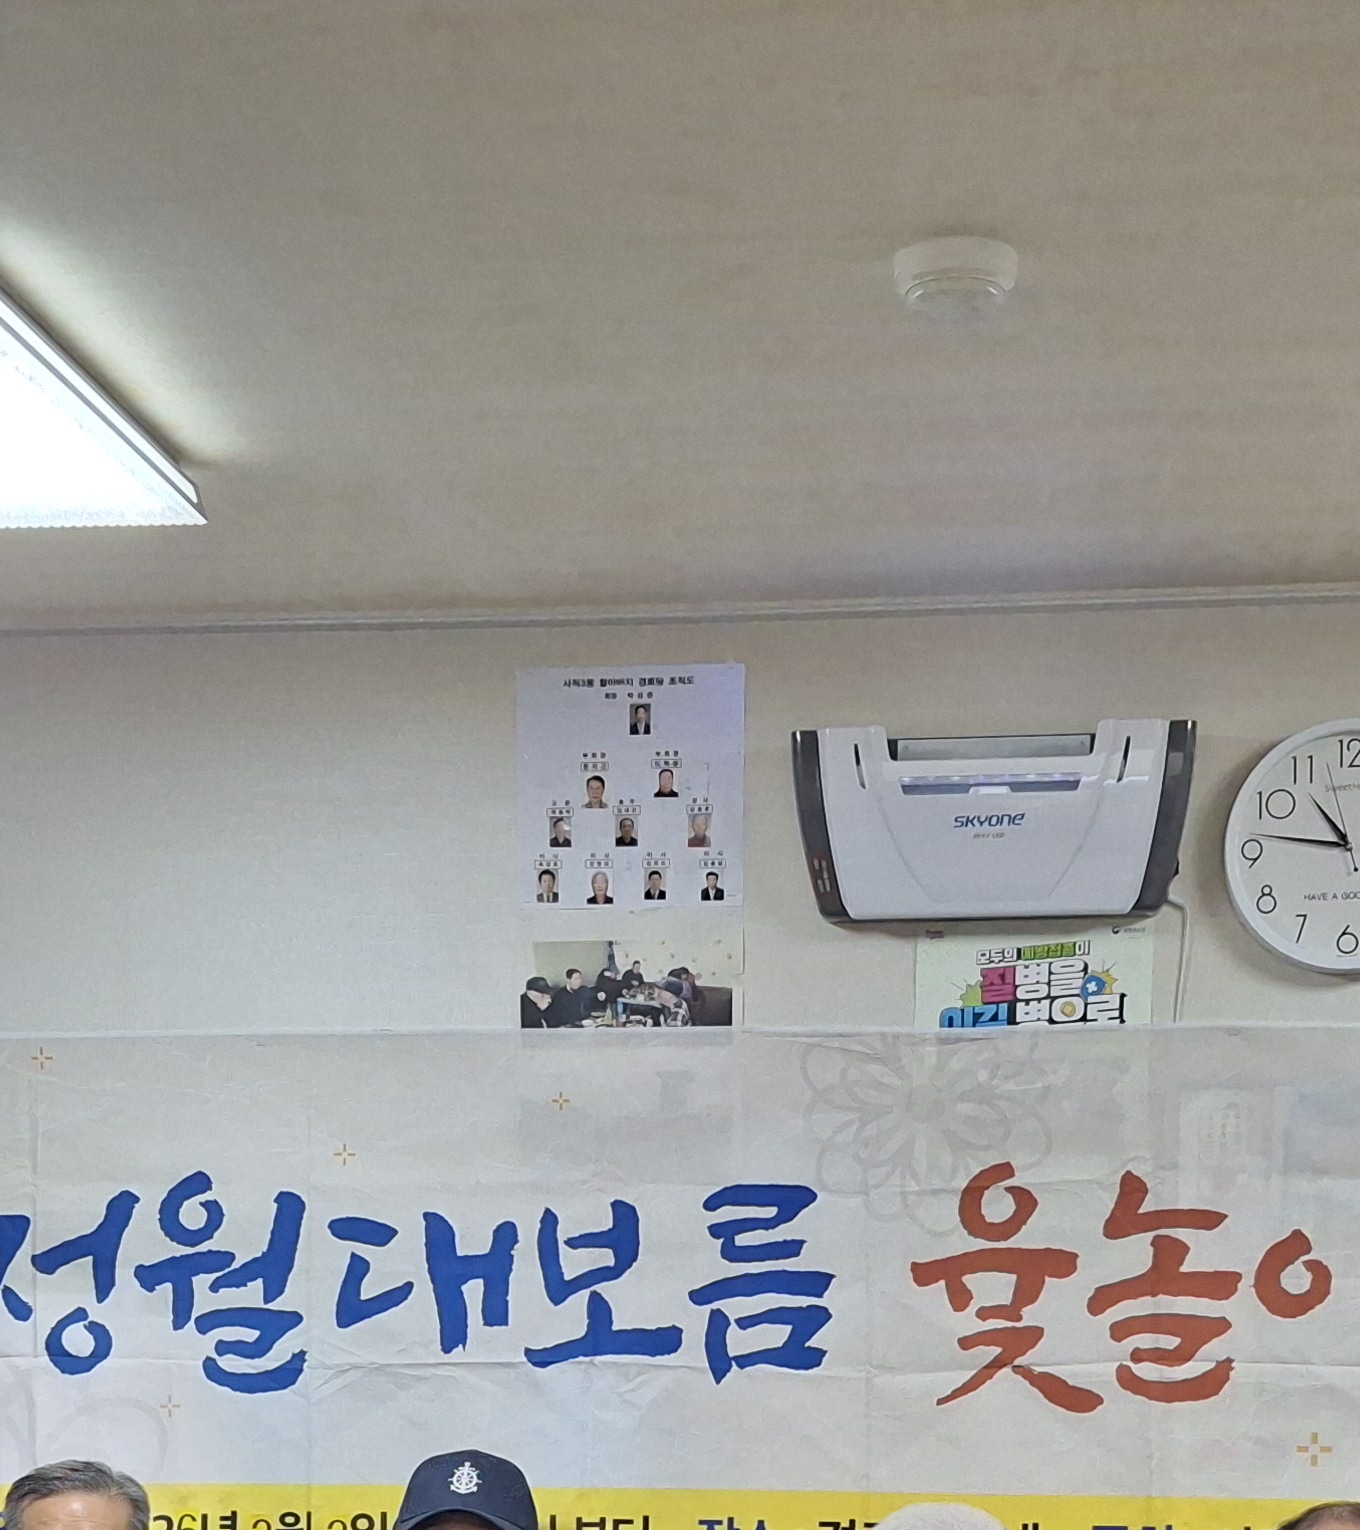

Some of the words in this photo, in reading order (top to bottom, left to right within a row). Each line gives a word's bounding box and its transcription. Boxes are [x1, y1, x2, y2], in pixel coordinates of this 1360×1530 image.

[1291, 755, 1313, 785] 11
[1256, 788, 1296, 820] 10
[1241, 839, 1263, 868] 9
[1256, 884, 1277, 914] 8
[1304, 893, 1329, 901] HAVE
[1331, 892, 1338, 900] A
[1295, 914, 1308, 944] 7
[1336, 924, 1359, 954] 6
[976, 948, 1020, 965] 모두의
[980, 959, 1086, 1004] 질병을
